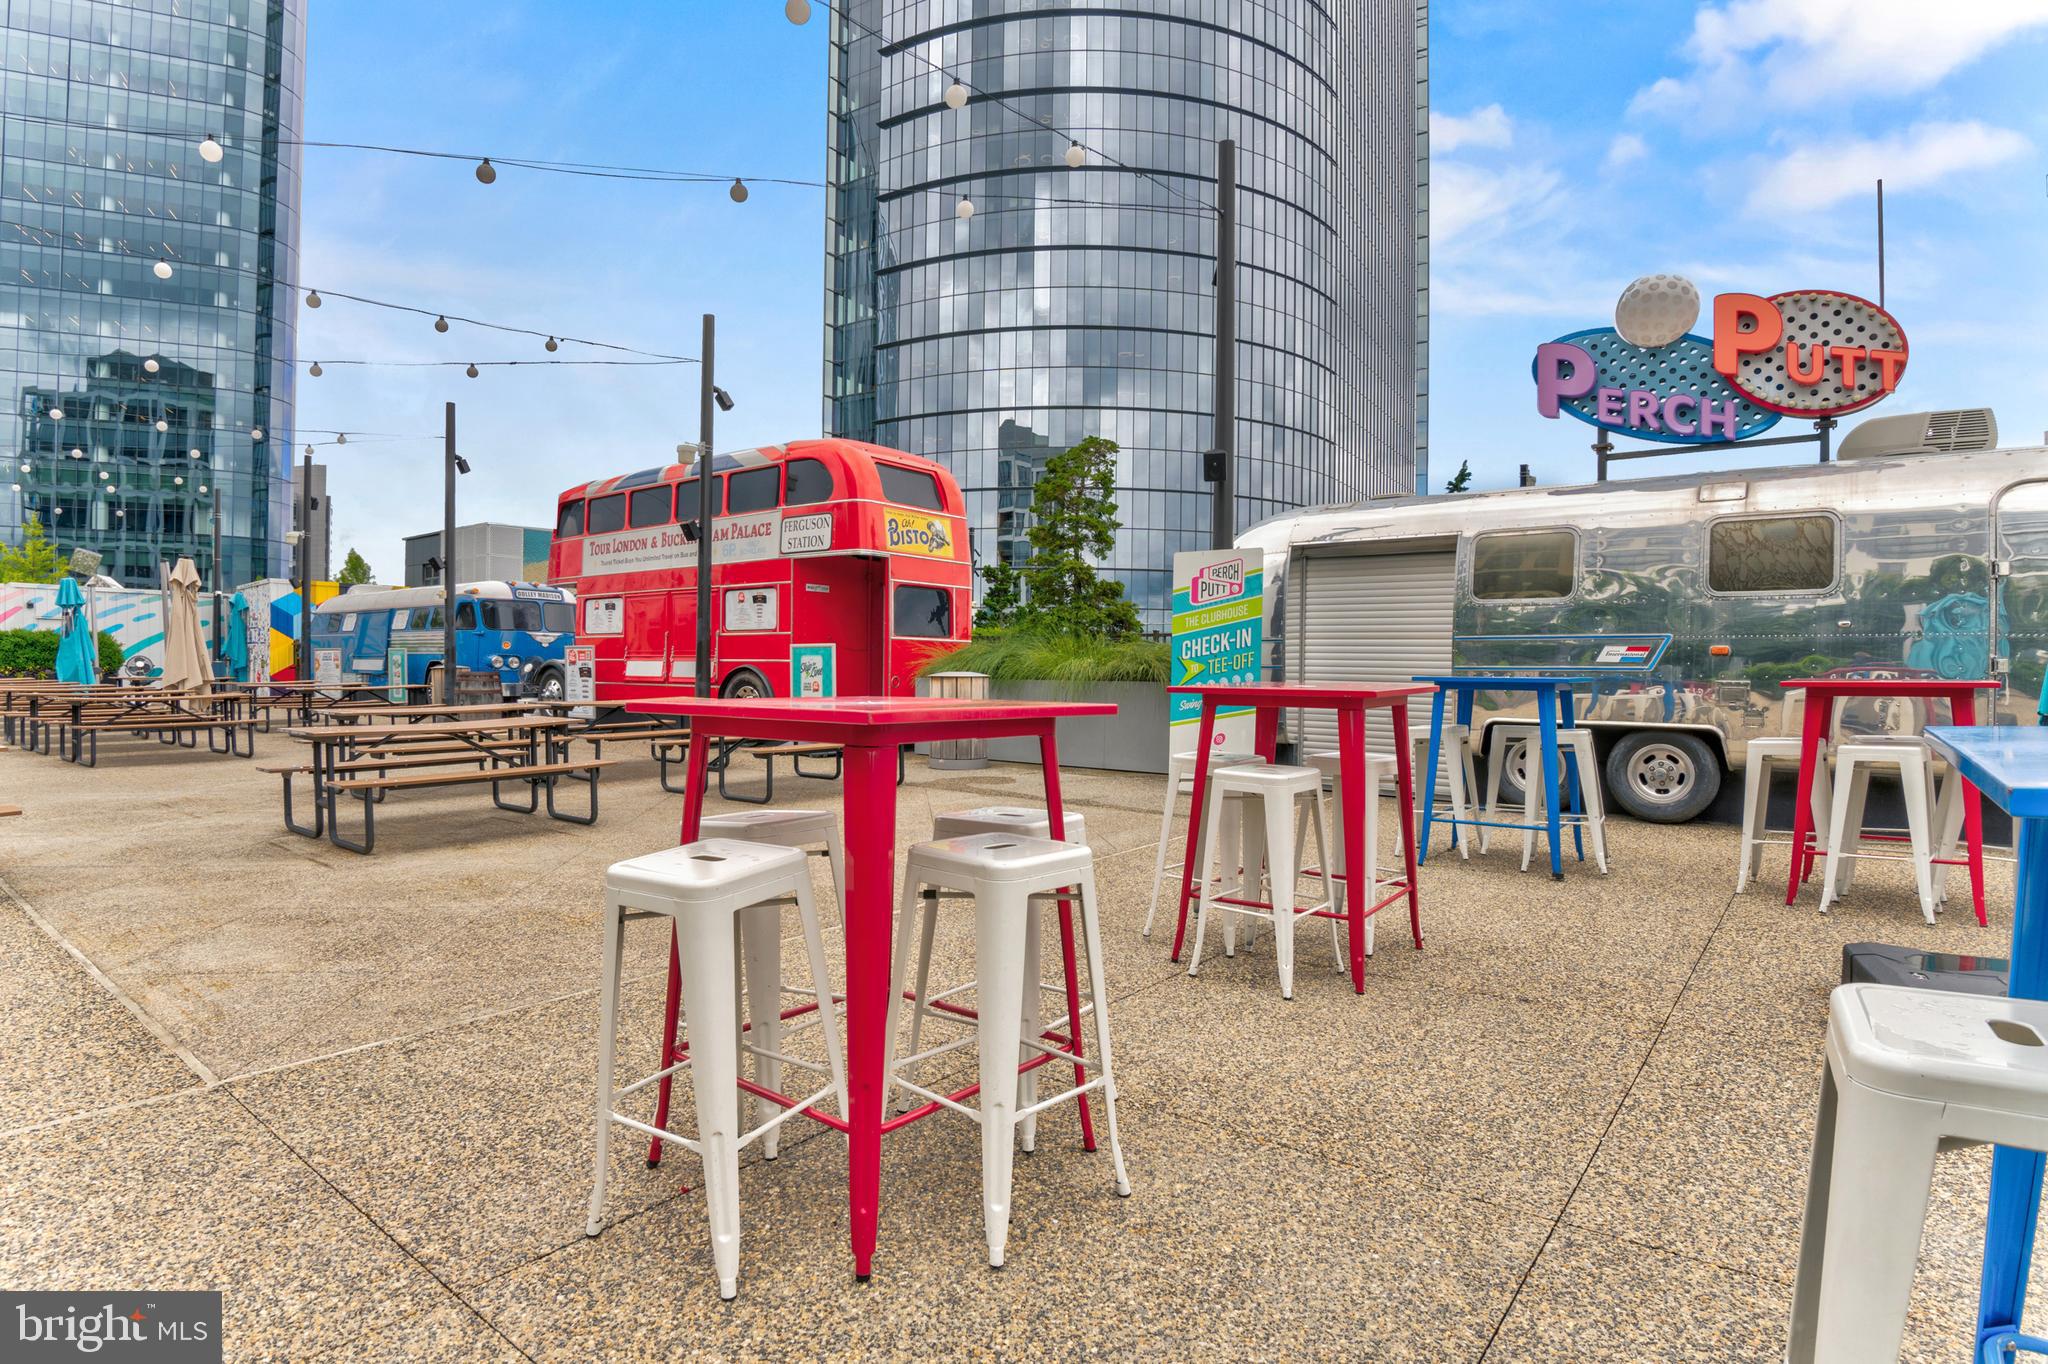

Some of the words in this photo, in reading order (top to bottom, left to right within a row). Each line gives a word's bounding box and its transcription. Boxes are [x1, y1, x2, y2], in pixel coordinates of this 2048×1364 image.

[1713, 293, 1906, 392] PUTT
[1537, 343, 1736, 442] PERCH
[784, 516, 831, 533] FERGUSON
[888, 518, 929, 546] BISTO
[590, 541, 611, 556] TOUR
[612, 538, 648, 554] LONDON
[651, 536, 658, 548] &
[731, 522, 772, 540] PALACE
[787, 535, 825, 550] STATION
[1212, 563, 1239, 581] PERCH
[1201, 581, 1227, 599] PUTT
[1185, 615, 1200, 628] THE
[1201, 604, 1249, 625] CLUBHOUSE
[1182, 627, 1252, 660] CHECK-IN
[1208, 652, 1255, 675] TEE-OFF
